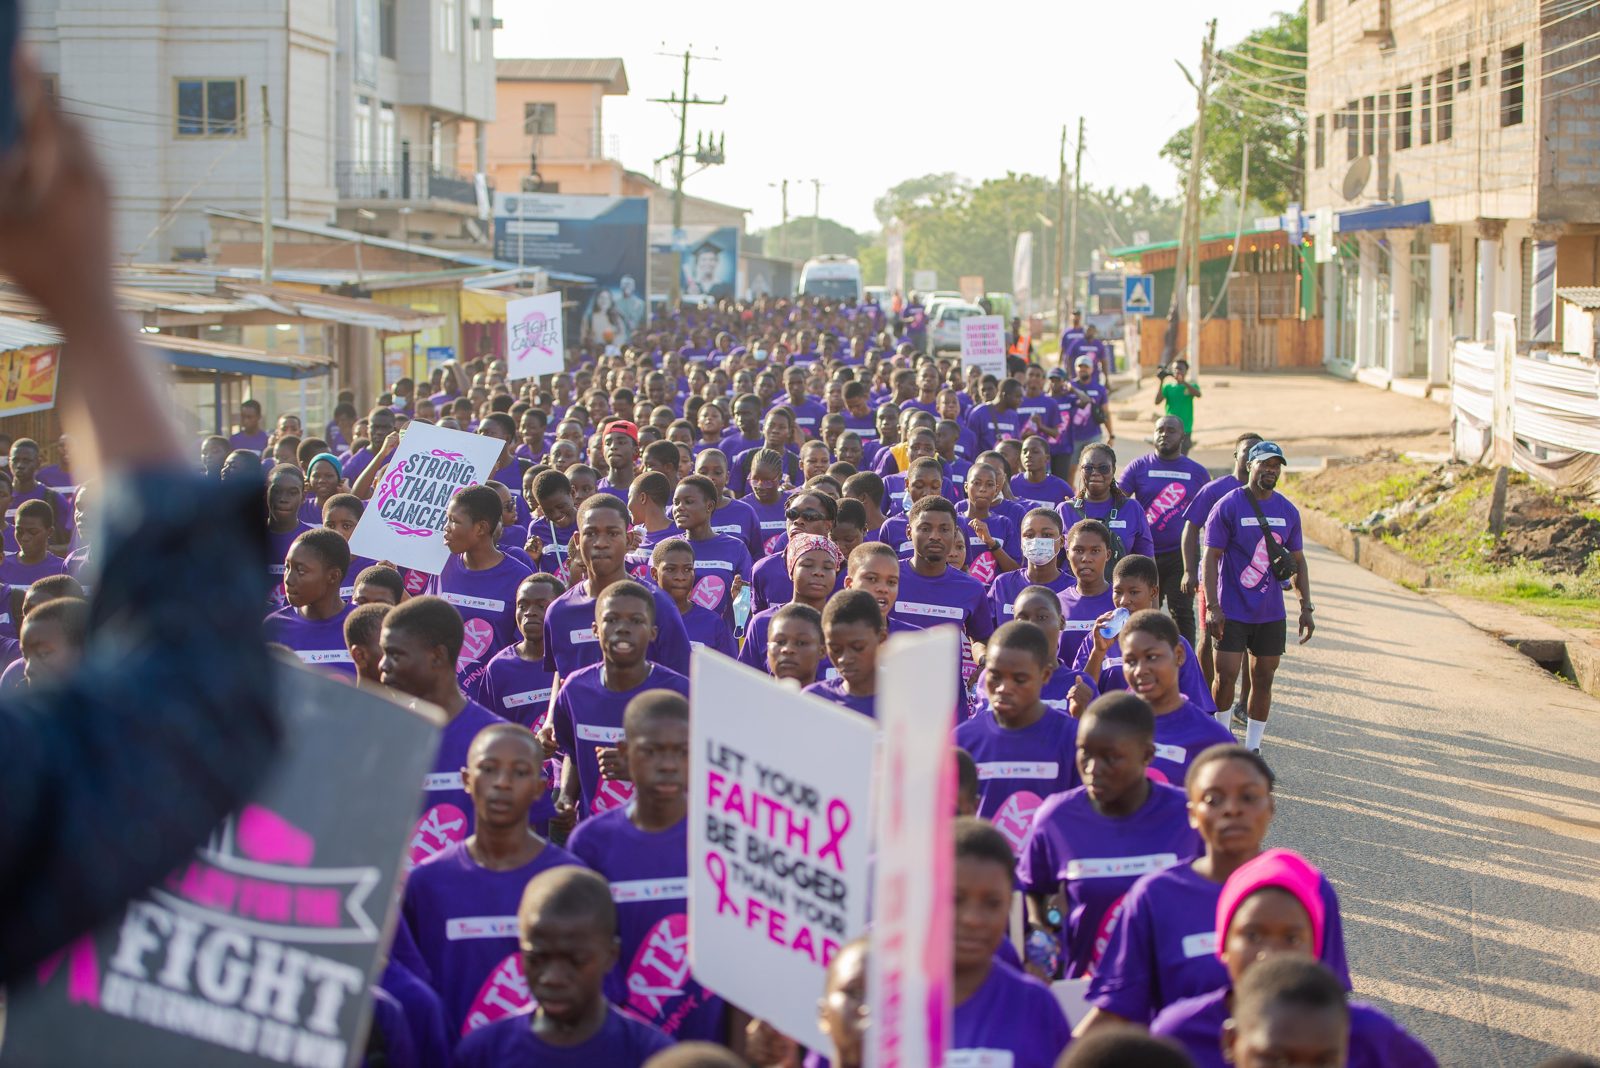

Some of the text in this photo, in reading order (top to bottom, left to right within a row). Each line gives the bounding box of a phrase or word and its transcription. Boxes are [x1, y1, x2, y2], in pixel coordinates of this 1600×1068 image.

[511, 331, 559, 351] CANCER
[512, 317, 557, 337] FIGHT
[399, 475, 455, 507] THAN
[404, 453, 475, 485] STRONG
[380, 499, 449, 532] CANCER
[707, 739, 820, 815] LET YOUR
[708, 770, 810, 855] FAITH
[706, 813, 848, 911] BE BIGGER
[731, 860, 846, 936] THAN YOUR
[109, 899, 364, 1037] FIGHT
